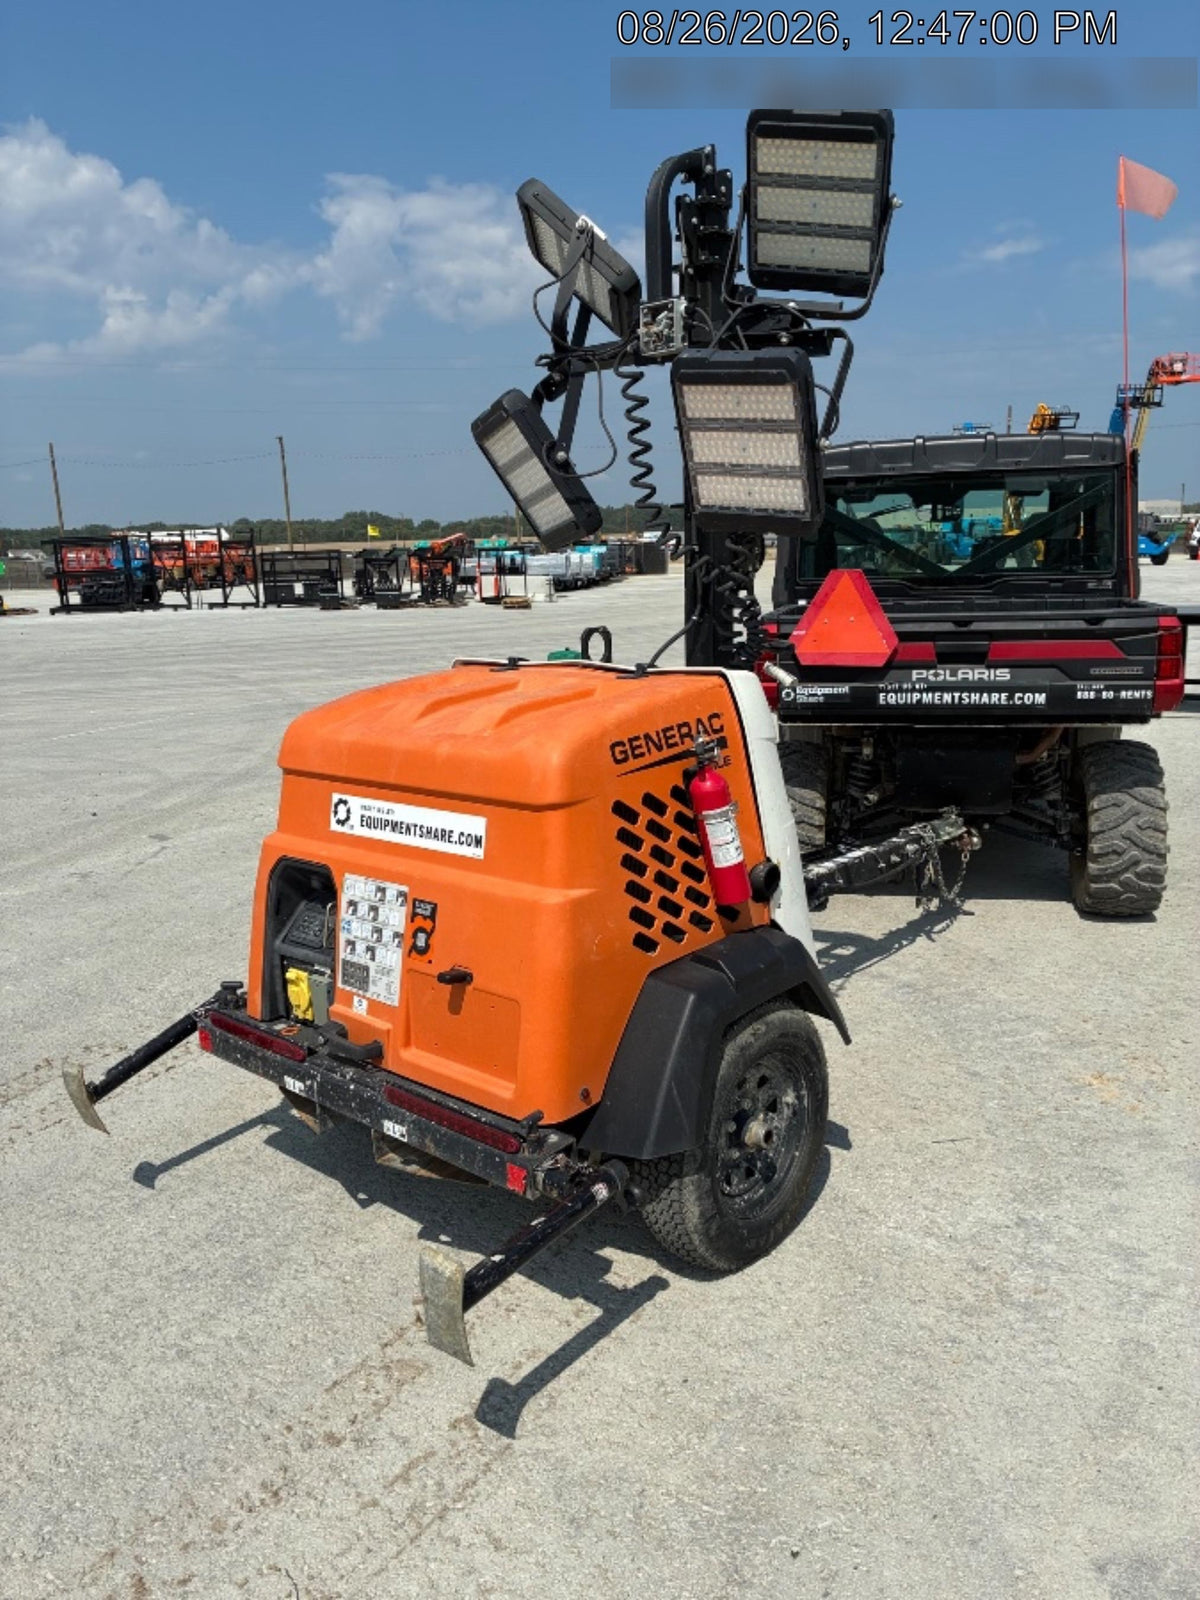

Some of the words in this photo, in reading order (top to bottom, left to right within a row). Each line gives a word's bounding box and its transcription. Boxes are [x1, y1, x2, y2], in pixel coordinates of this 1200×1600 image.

[911, 668, 1011, 682] POLARIS
[879, 692, 1047, 705] EQUIPMENTSHARE.COM
[609, 712, 725, 765] GENERAC
[360, 814, 483, 849] EQUIPMENTSHARE.COM
